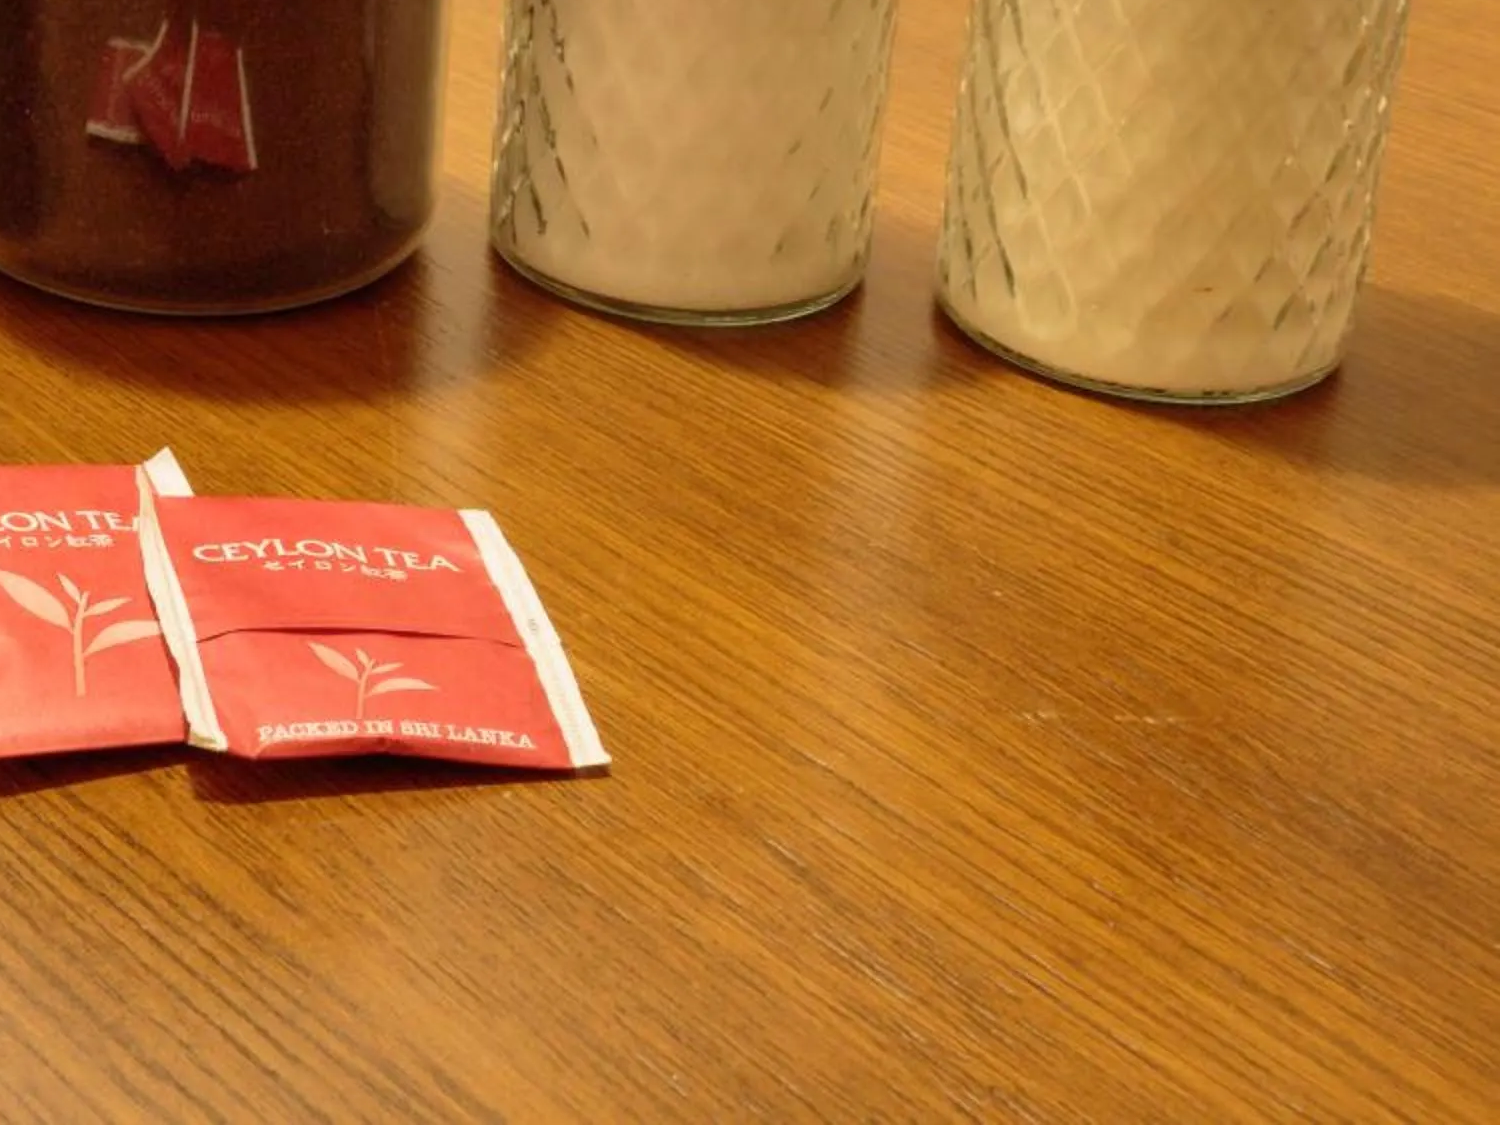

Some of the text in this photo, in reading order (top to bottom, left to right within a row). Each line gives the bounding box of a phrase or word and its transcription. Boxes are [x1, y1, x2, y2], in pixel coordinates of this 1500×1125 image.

[192, 538, 465, 573] CEYLON TEA
[258, 719, 538, 749] PACKED IN SRI LANKA
